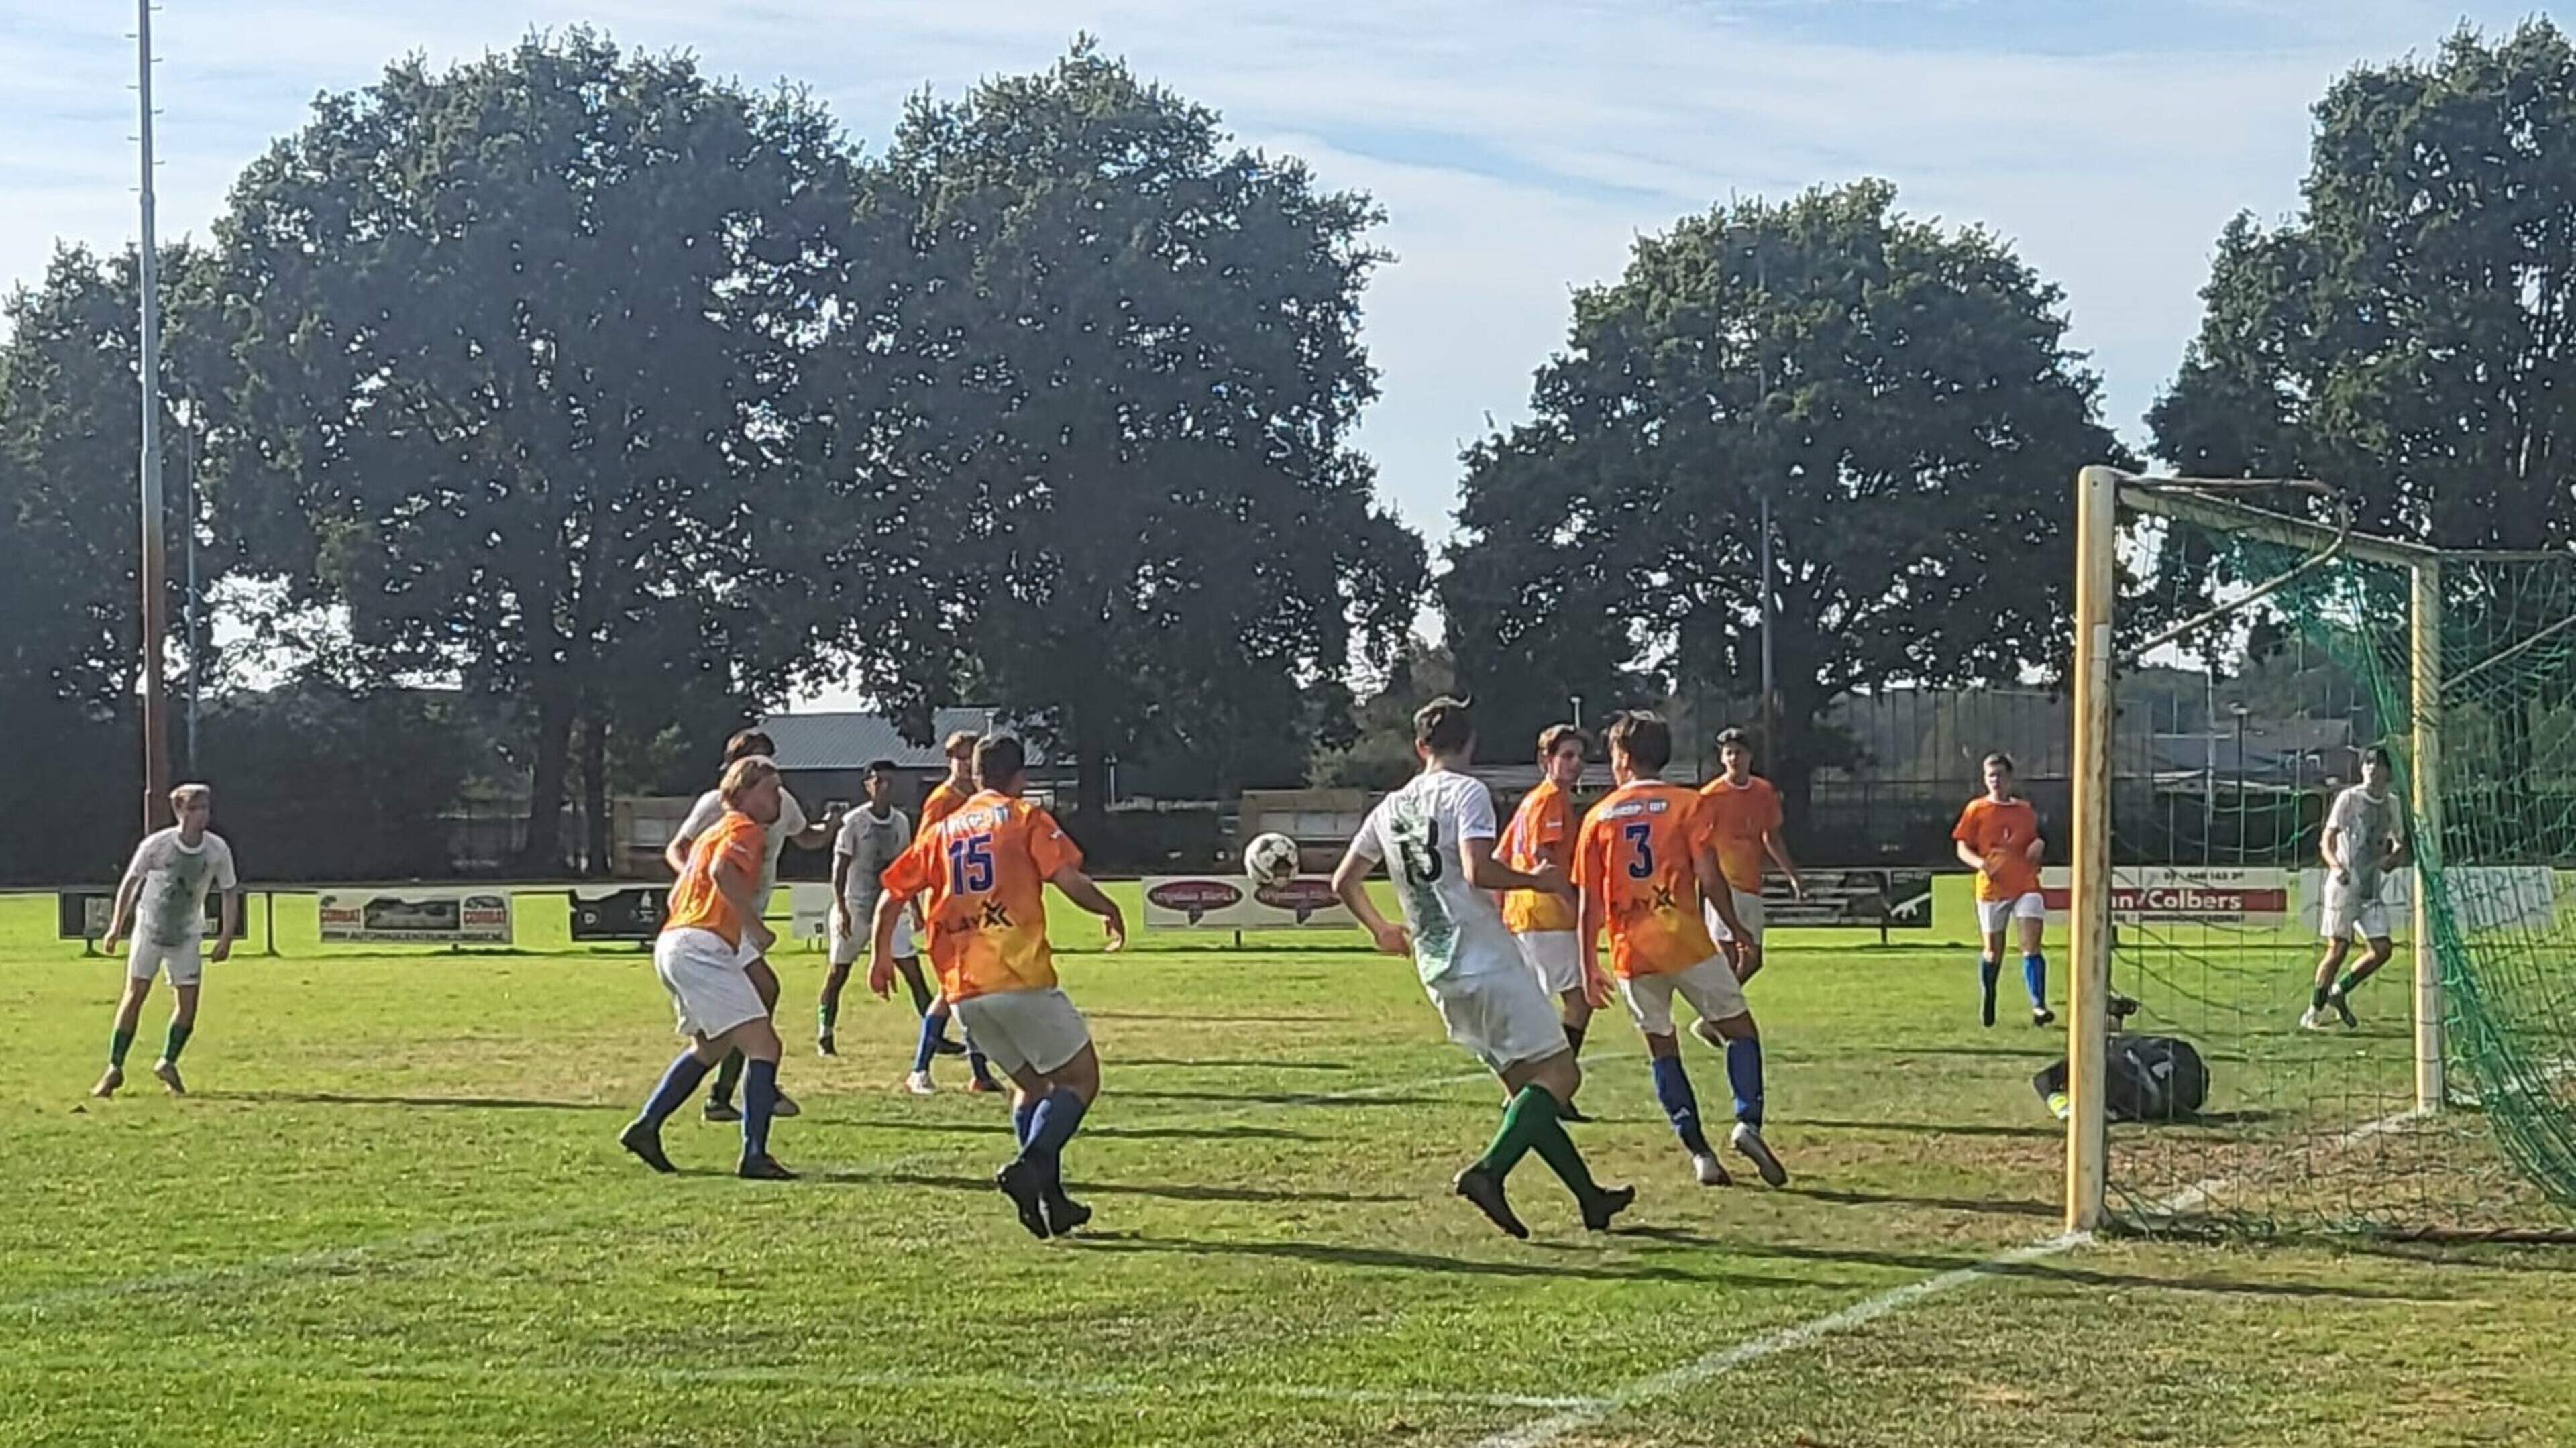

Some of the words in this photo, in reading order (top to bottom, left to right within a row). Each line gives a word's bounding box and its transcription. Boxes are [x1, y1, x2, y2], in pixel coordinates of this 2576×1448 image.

[948, 834, 995, 896] 15
[1625, 822, 1654, 879] 3
[2148, 890, 2241, 909] Colbers
